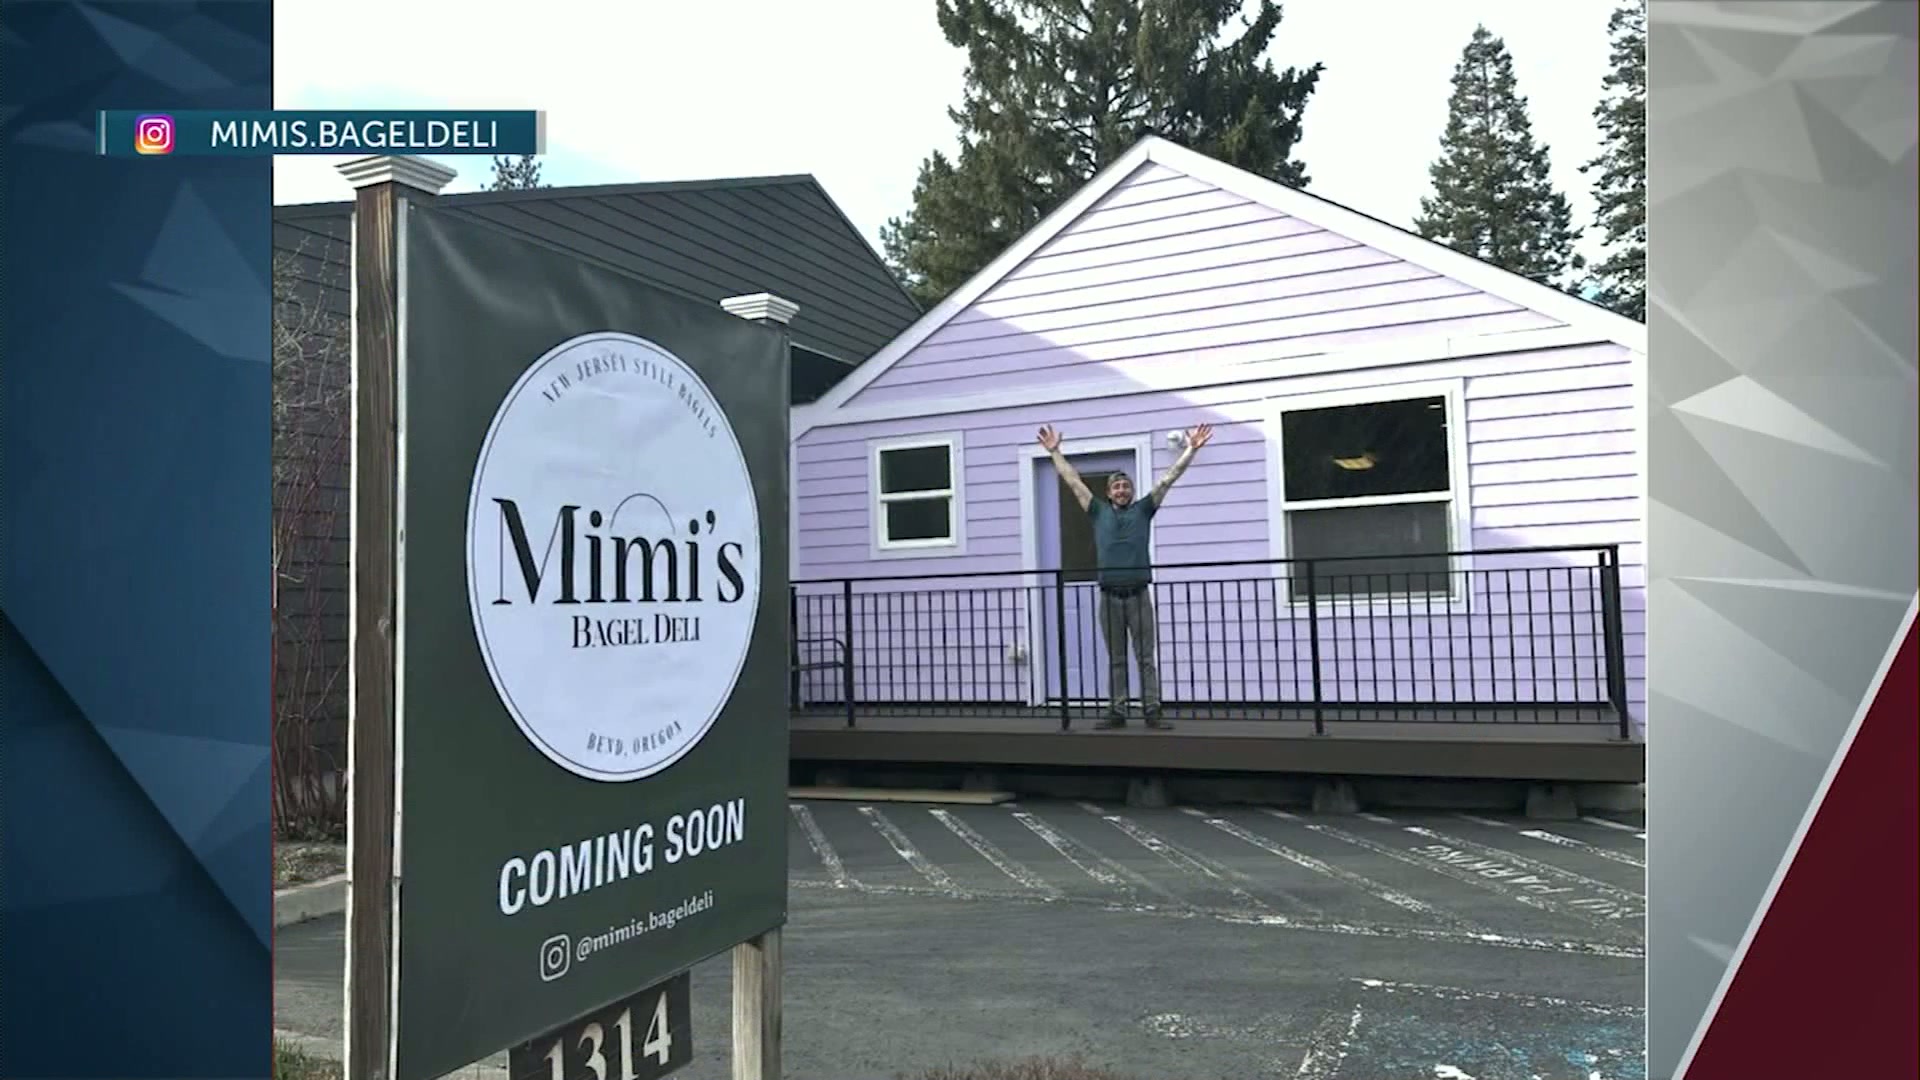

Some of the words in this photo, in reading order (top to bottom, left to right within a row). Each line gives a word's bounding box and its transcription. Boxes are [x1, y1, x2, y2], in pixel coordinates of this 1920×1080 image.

[542, 373, 572, 404] NEW
[576, 354, 627, 382] JERSEY
[633, 357, 674, 390] STYLE
[678, 382, 718, 440] BAGELS
[491, 497, 745, 605] Mimi's
[572, 614, 649, 649] BAGEL
[654, 613, 701, 644] DELI
[586, 731, 628, 758] BEND,
[633, 720, 682, 755] OREGON
[499, 822, 655, 916] COMING
[664, 797, 745, 864] SOON
[576, 889, 714, 962] @mimis.bageldeli
[543, 990, 673, 1080] 1314
